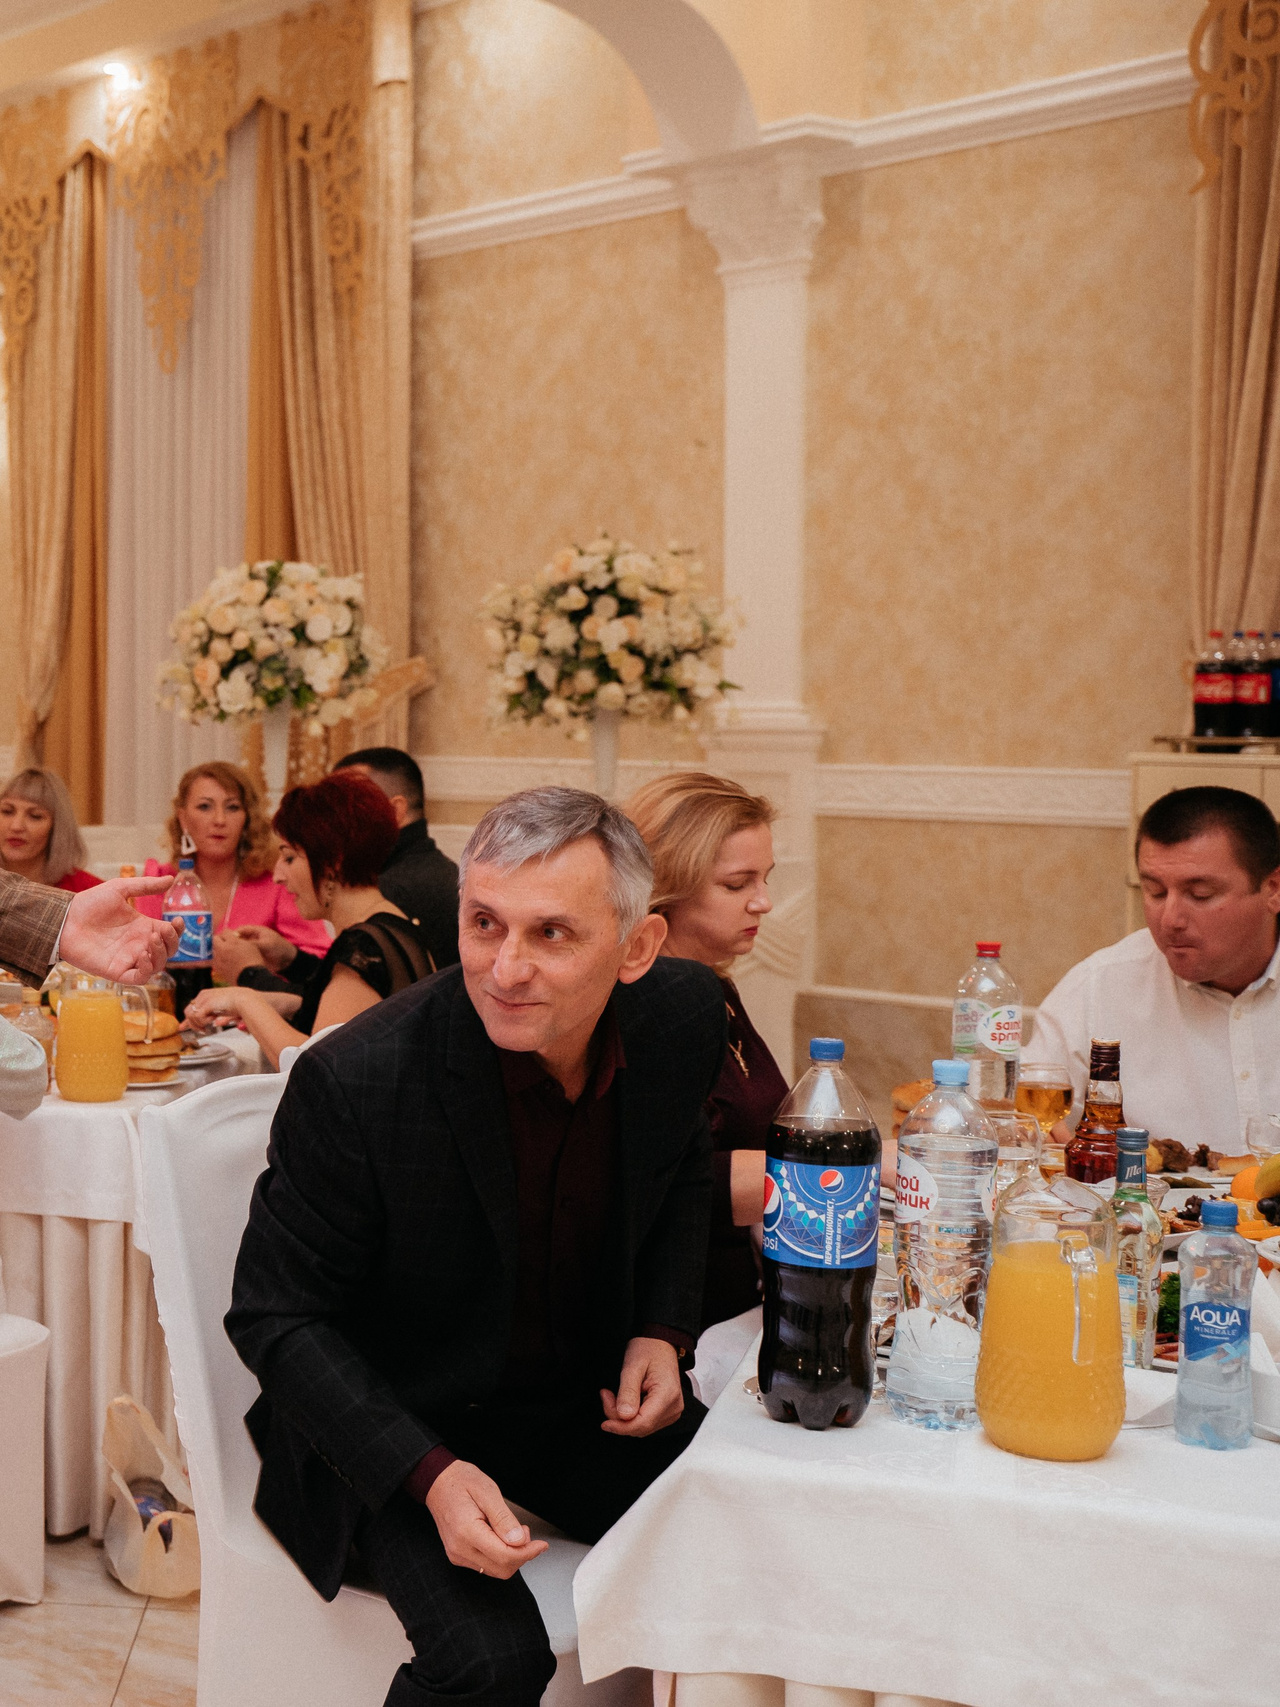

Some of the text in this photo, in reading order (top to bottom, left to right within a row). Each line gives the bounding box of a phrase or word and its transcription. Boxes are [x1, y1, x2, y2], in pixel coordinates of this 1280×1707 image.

[990, 1032, 1021, 1045] sprin
[762, 1234, 780, 1251] psi
[1189, 1305, 1242, 1329] AQUA
[1193, 1326, 1238, 1336] MINERALE
